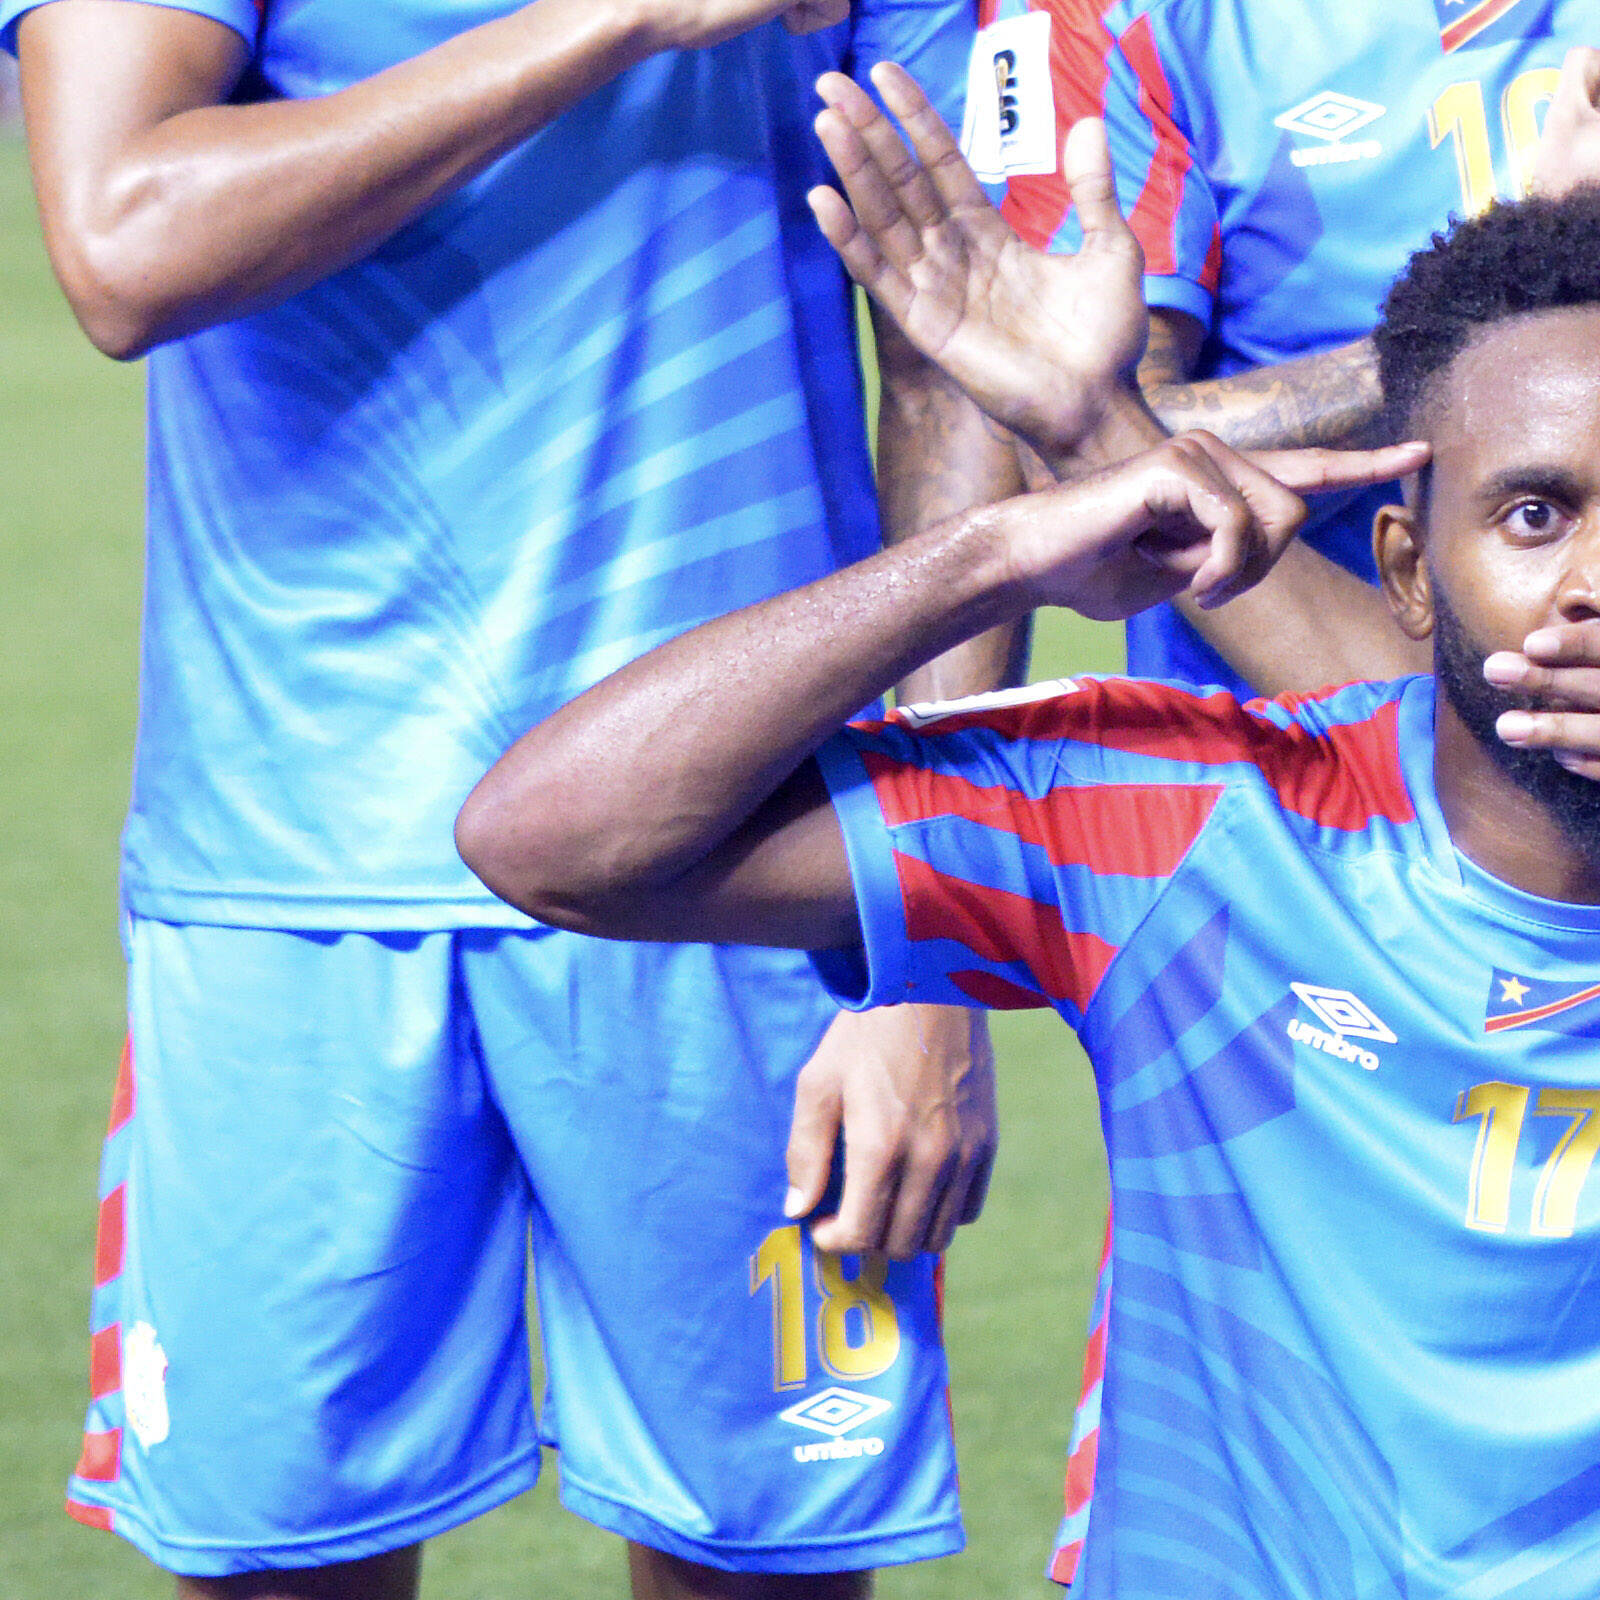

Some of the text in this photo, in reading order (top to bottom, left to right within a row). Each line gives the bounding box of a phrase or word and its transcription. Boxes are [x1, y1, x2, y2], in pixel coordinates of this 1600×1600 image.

[1286, 1019, 1380, 1071] umbro
[749, 1224, 901, 1393] 18
[793, 1436, 885, 1463] umbro
